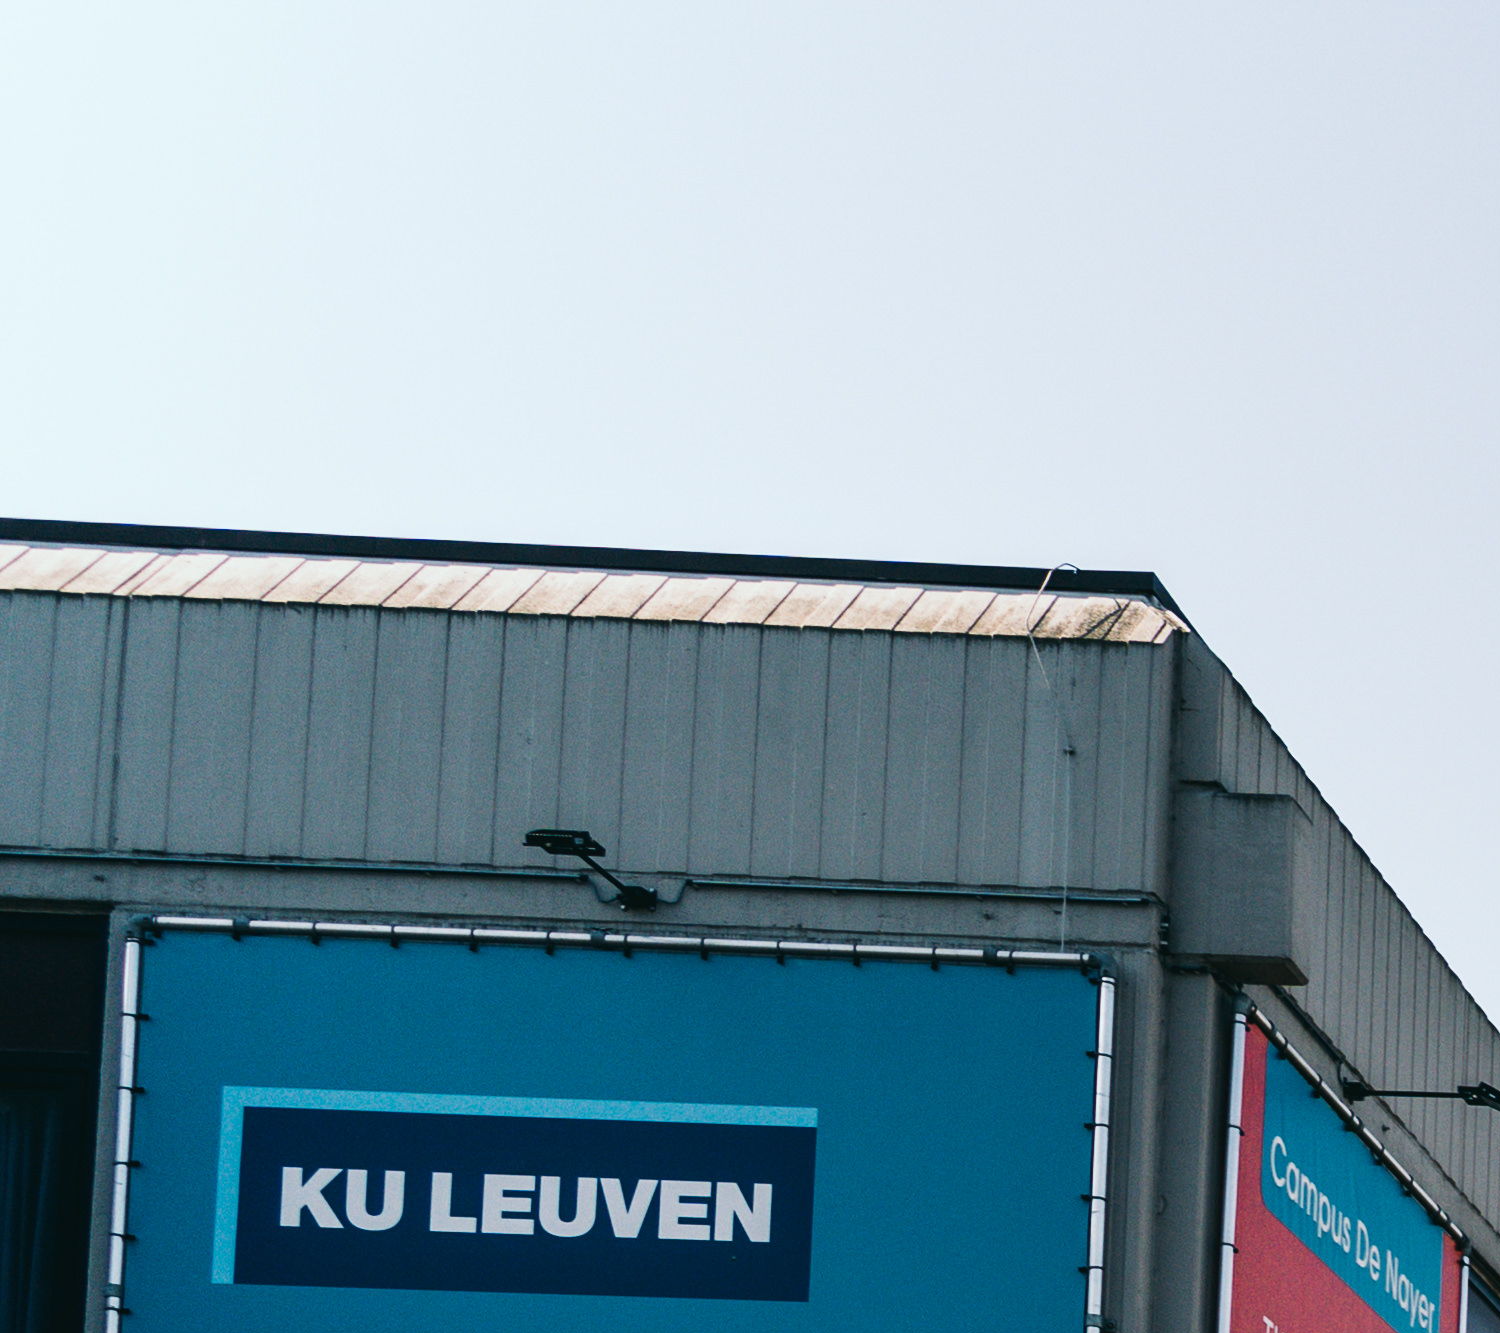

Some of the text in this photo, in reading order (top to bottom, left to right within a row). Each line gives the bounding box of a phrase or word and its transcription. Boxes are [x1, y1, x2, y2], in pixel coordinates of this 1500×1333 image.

[279, 1166, 774, 1244] KU LEUVEN
[1270, 1135, 1351, 1253] Campus
[1355, 1218, 1381, 1282] De
